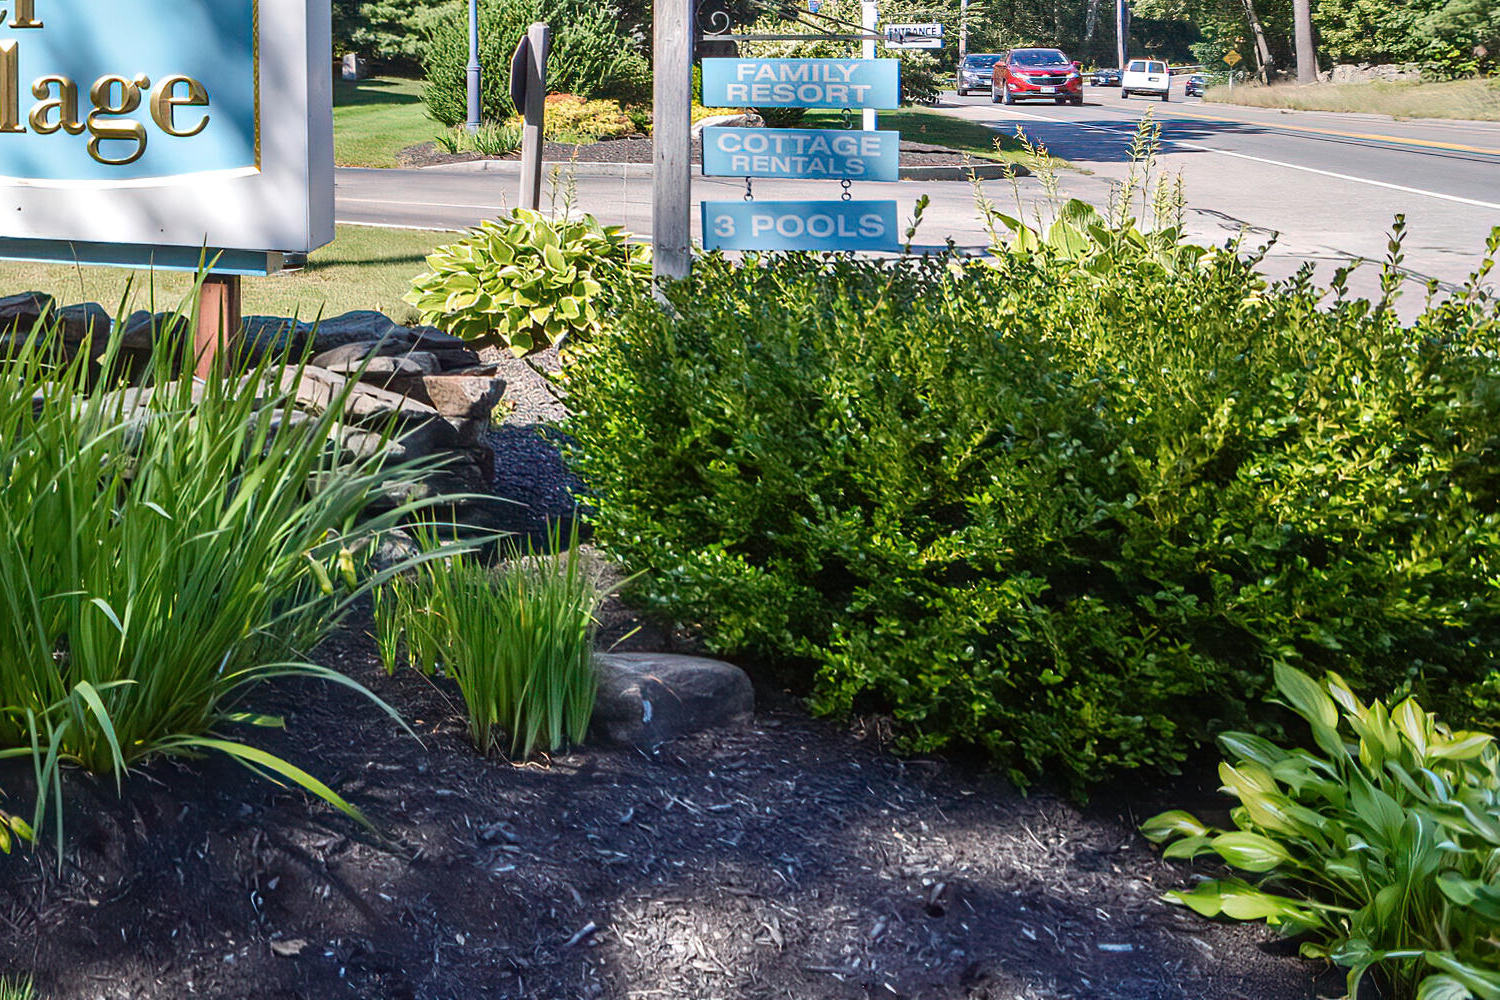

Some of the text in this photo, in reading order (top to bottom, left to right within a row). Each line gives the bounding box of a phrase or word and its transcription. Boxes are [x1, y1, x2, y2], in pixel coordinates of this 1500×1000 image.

[736, 63, 861, 82] FAMILY
[726, 83, 872, 104] RESORT
[717, 133, 882, 158] COTTAGE
[731, 155, 866, 176] RENTALS
[714, 214, 886, 238] 3 POOLS
